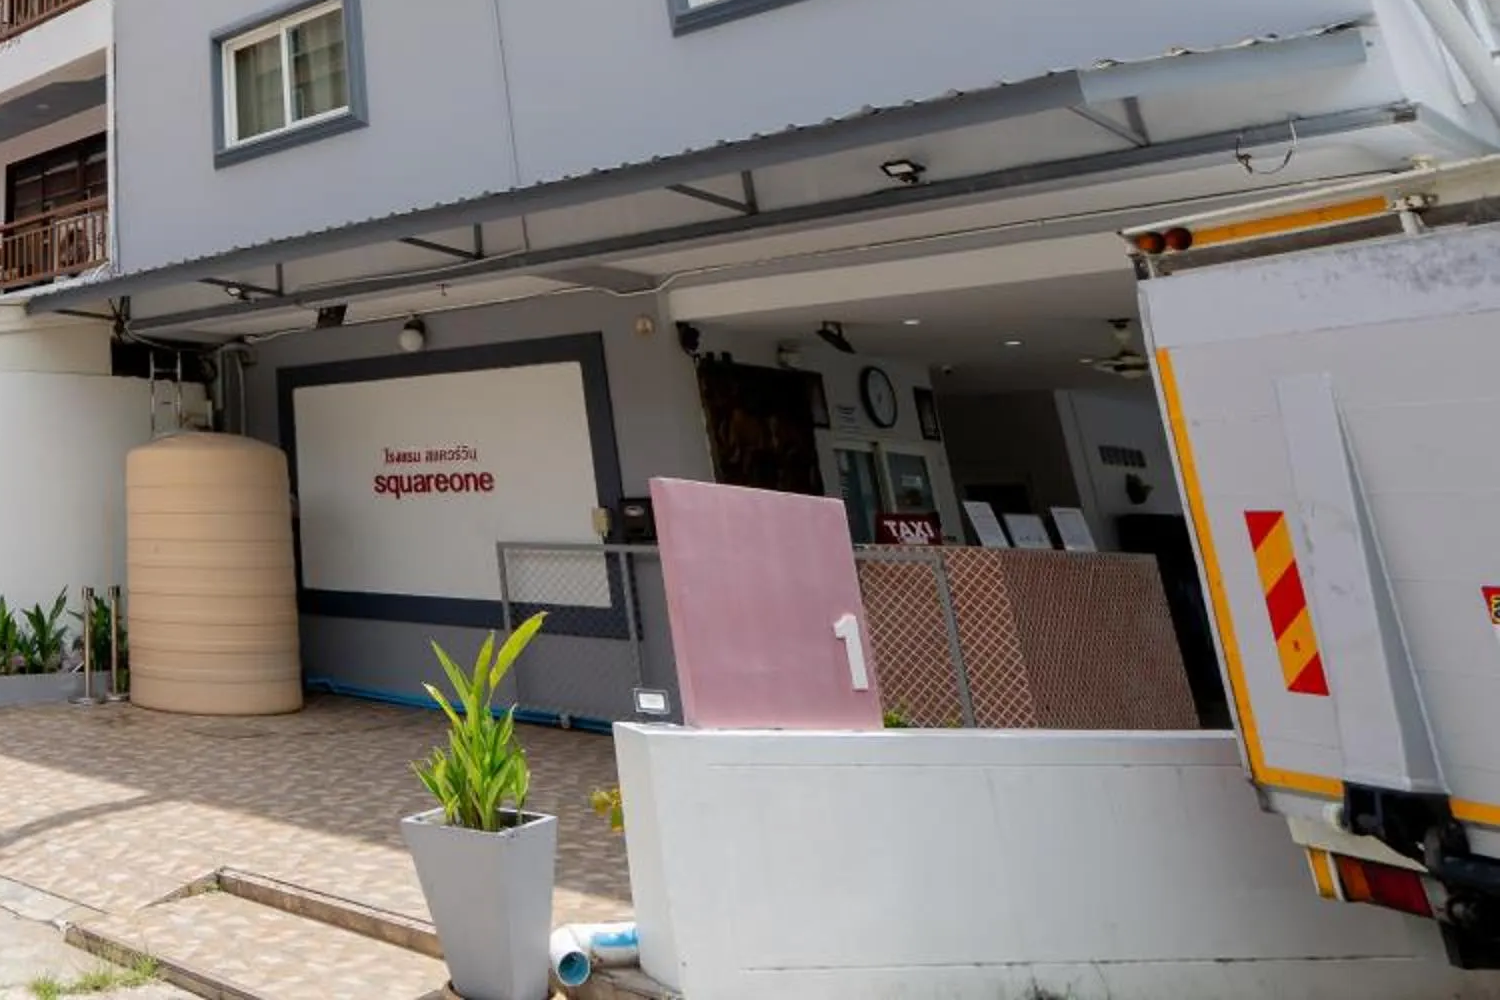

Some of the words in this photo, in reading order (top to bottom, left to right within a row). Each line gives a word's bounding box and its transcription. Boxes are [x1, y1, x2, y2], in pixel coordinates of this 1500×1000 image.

[374, 472, 494, 499] squareone
[883, 520, 934, 537] TAXI
[833, 614, 868, 690] 1
